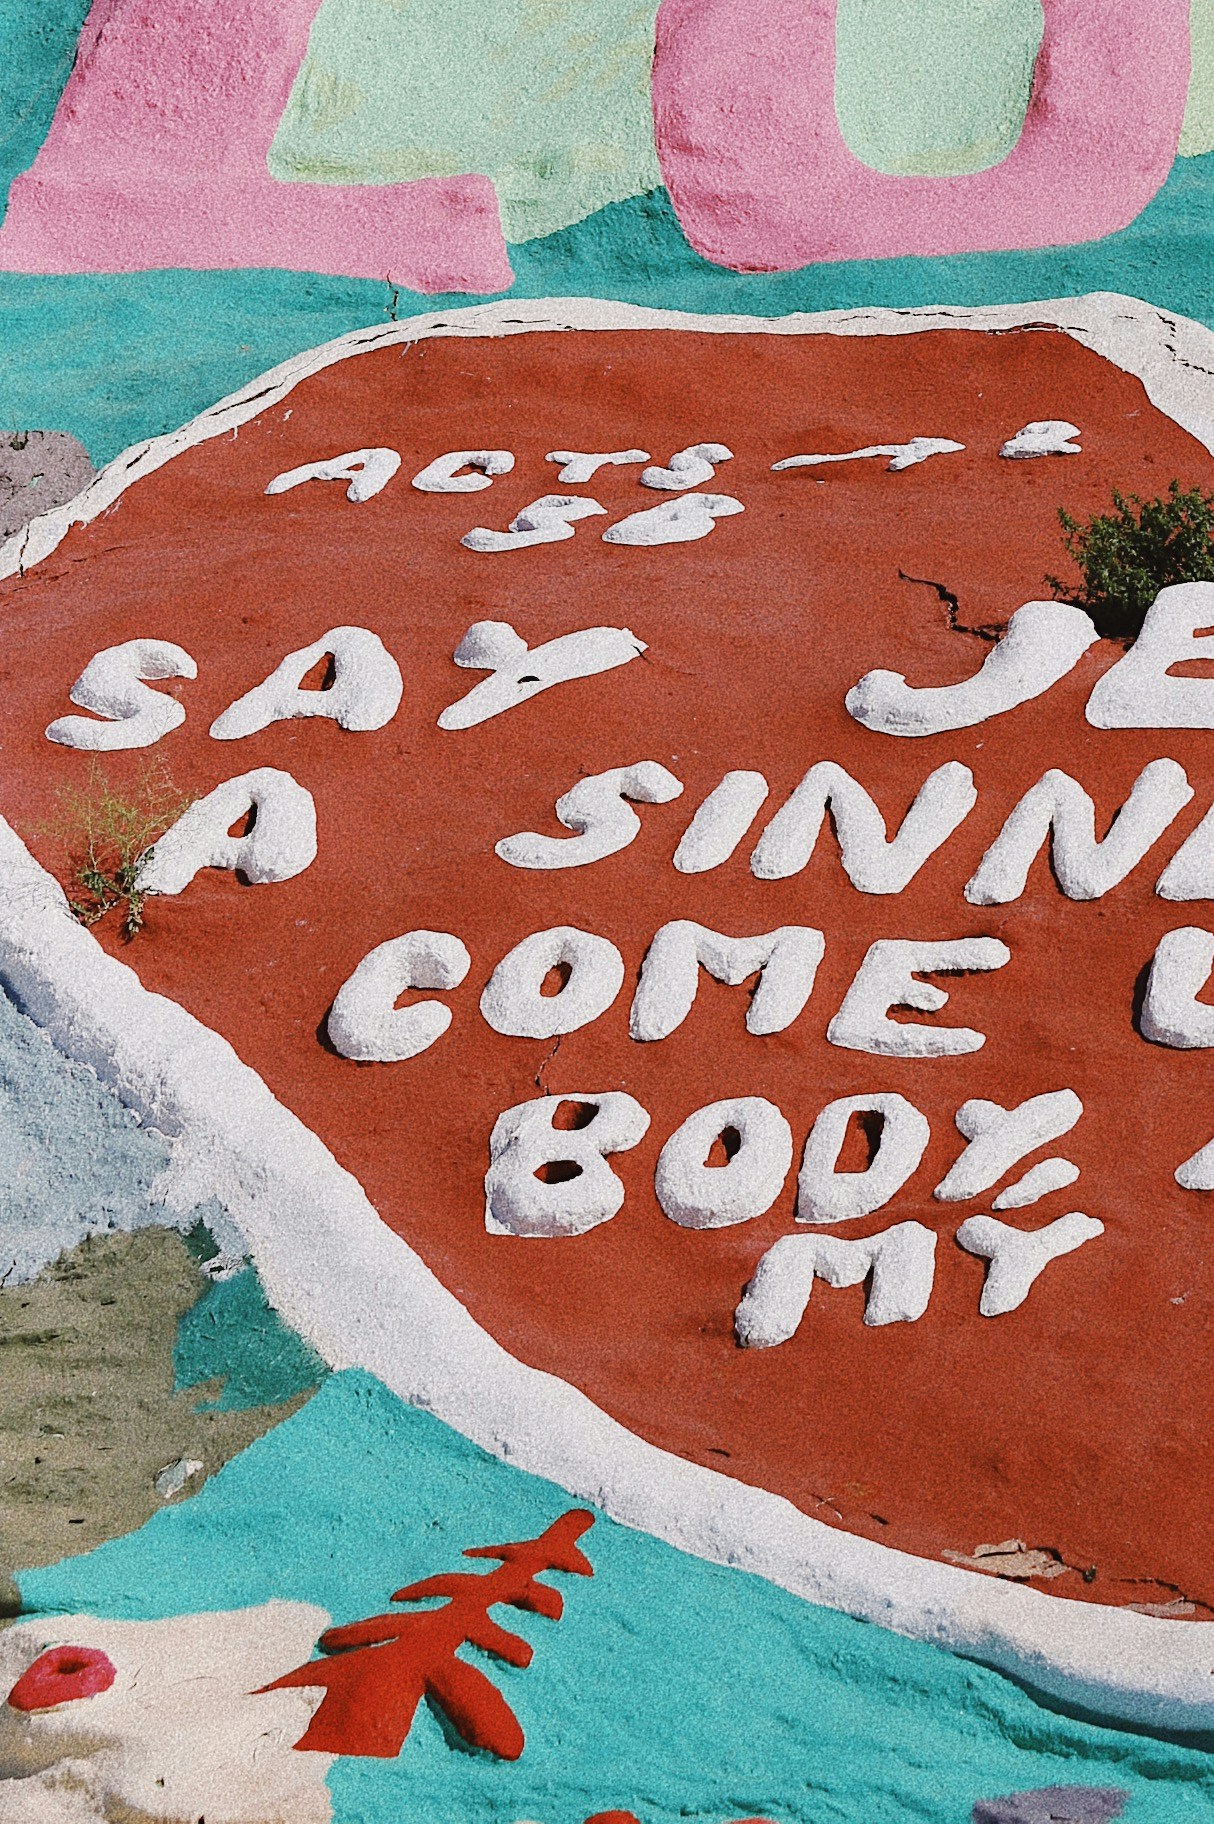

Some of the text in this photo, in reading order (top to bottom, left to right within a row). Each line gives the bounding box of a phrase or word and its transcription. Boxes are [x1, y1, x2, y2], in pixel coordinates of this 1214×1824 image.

[264, 442, 734, 503] ACTS
[45, 618, 649, 752] SAY
[132, 766, 318, 897] A
[327, 920, 1011, 1063] COME
[735, 1210, 1105, 1349] MY
